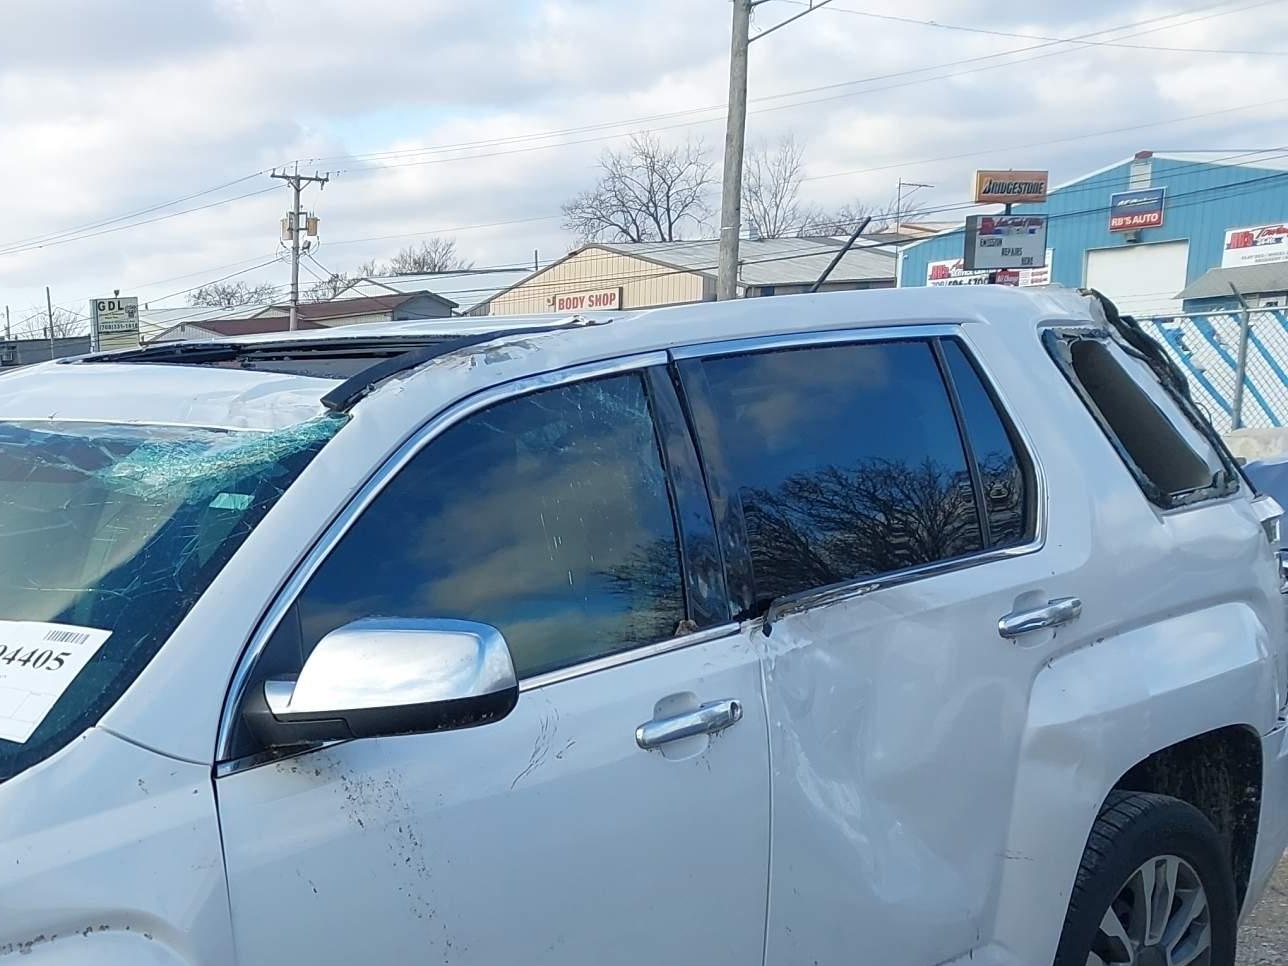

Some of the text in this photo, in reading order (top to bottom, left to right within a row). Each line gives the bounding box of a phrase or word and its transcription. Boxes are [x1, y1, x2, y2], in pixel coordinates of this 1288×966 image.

[983, 179, 1044, 194] BRIDGESTONE
[1132, 213, 1159, 224] AUTO
[97, 300, 125, 312] GDL
[558, 292, 616, 311] BODY SHOP
